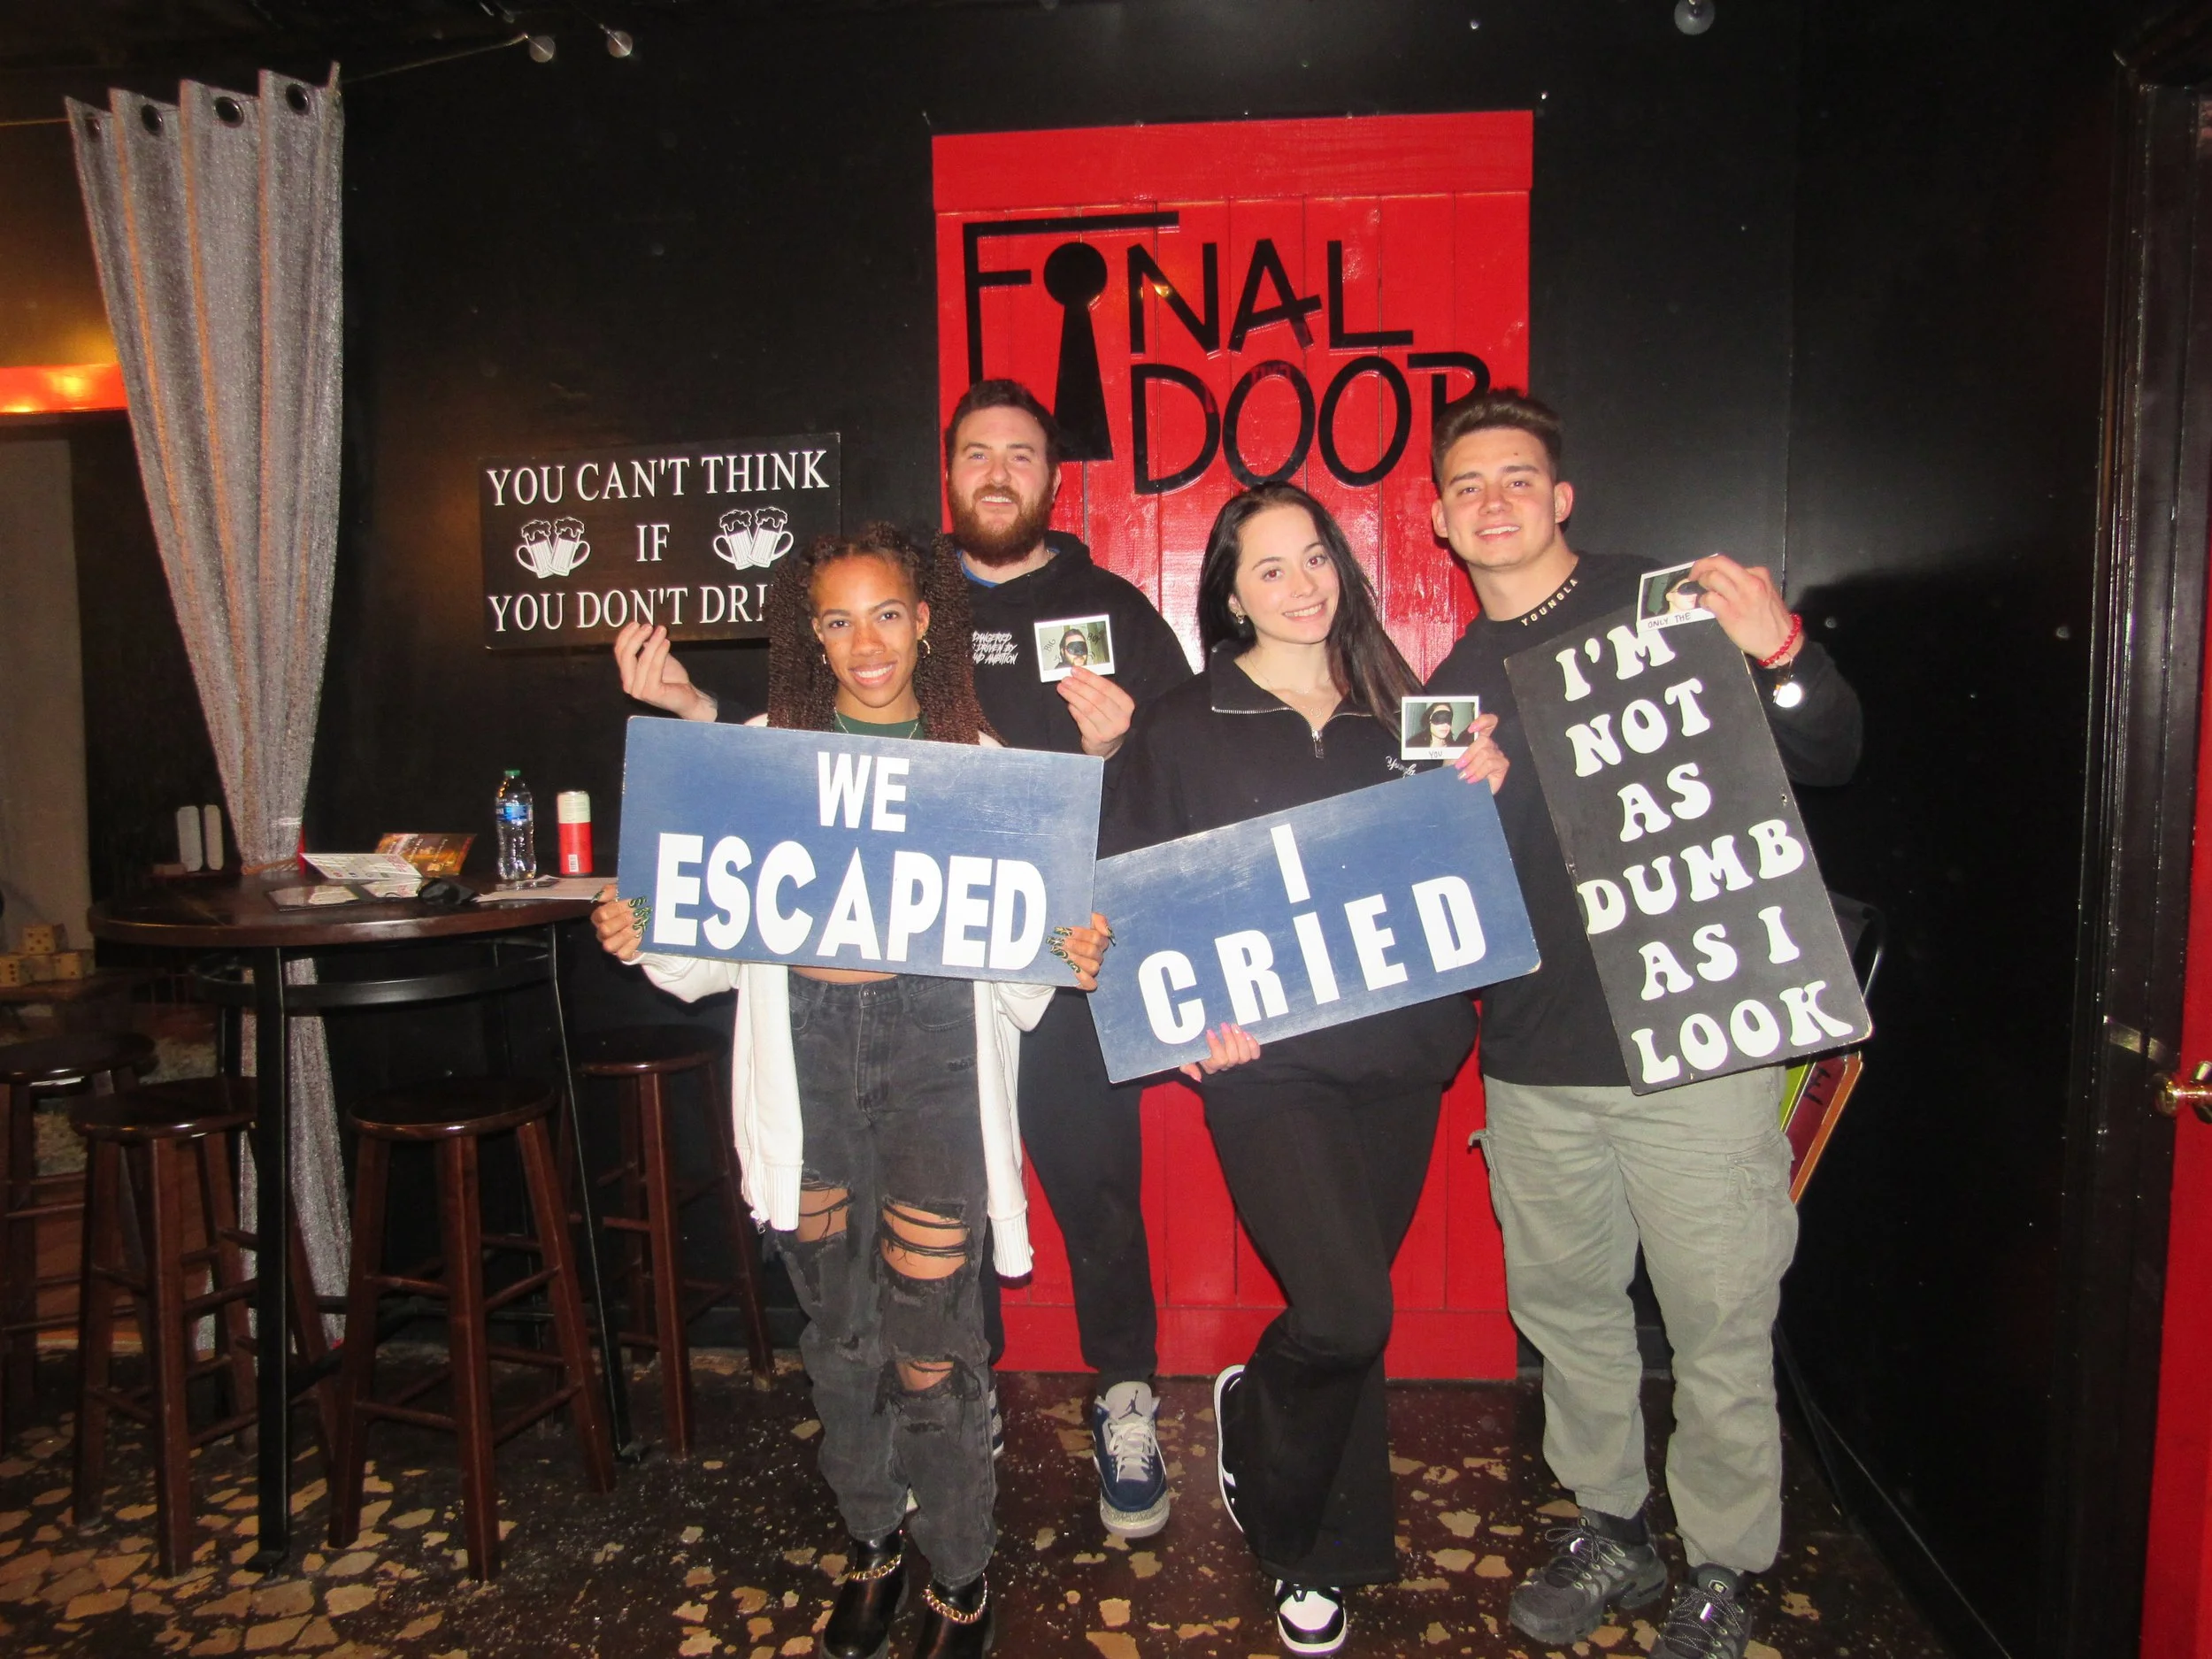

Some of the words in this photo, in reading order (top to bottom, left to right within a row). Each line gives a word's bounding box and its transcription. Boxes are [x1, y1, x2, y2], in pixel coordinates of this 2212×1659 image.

[486, 465, 565, 506] YOU
[576, 457, 690, 501] CAN'T
[701, 449, 830, 495] THINK
[635, 523, 671, 563] IF
[488, 593, 566, 632] YOU
[576, 587, 688, 628] DON'T
[700, 584, 774, 623] DRI
[1647, 616, 1670, 629] ONLY
[1674, 611, 1692, 622] THE
[1555, 624, 1676, 702] I'M
[1565, 678, 1711, 778] NOT
[817, 751, 910, 833] WE
[1617, 762, 1712, 842] AS
[652, 832, 1048, 971] ESCAPED
[1270, 823, 1311, 904] I
[1576, 818, 1805, 935] DUMB
[1137, 875, 1487, 1045] CRIED
[1638, 923, 1739, 1002] AS
[1757, 905, 1801, 964] I
[1631, 979, 1854, 1084] LOOK
